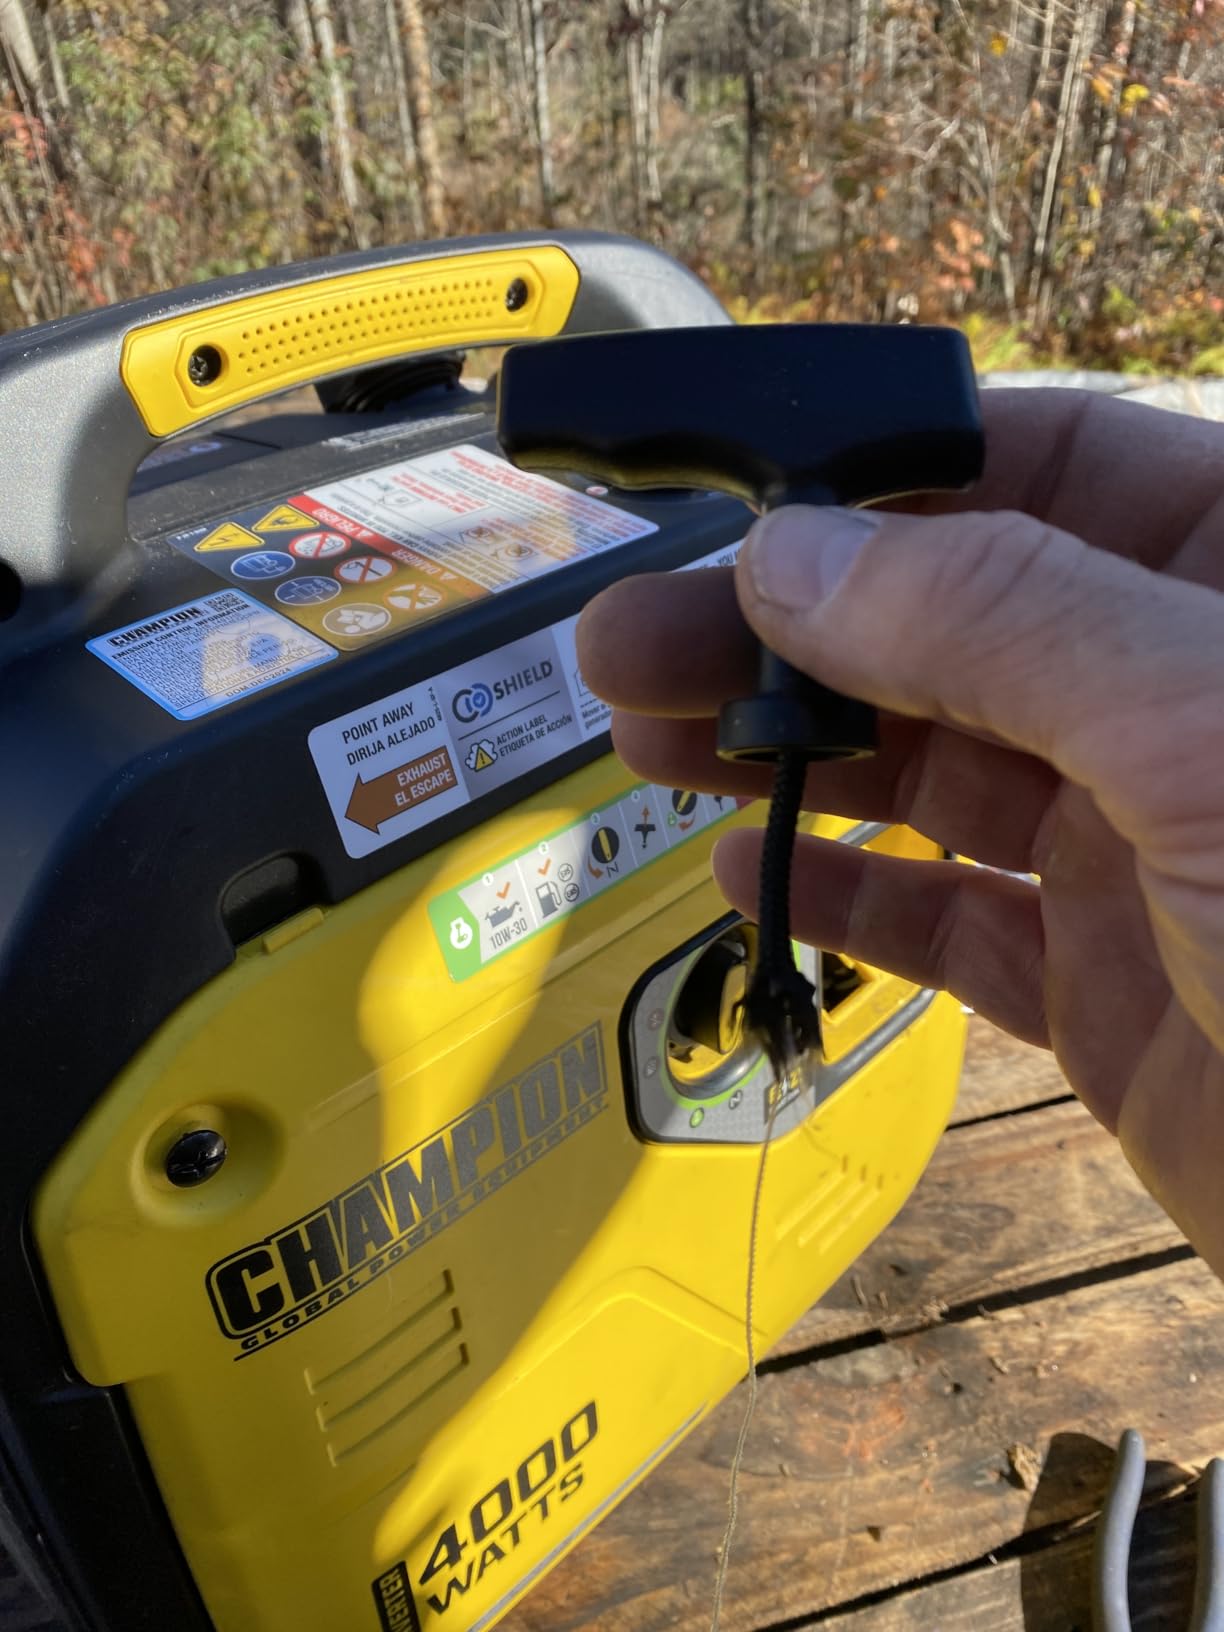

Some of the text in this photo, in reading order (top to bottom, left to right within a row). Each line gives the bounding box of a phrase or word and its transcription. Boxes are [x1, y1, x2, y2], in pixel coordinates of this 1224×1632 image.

[392, 549, 440, 574] DANGER
[107, 606, 202, 646] CHAMPION
[111, 640, 155, 659] EMISSION
[153, 624, 194, 642] CONTROL
[193, 603, 250, 626] INFORMATION
[493, 660, 553, 700] SHIELD
[342, 718, 378, 744] POINT
[382, 702, 414, 727] AWAY
[347, 716, 436, 765] DIRIJA ALEJADO
[497, 714, 548, 746] ACTION LABEL
[499, 714, 572, 757] ETIQUETA DE ACCIÓN
[394, 768, 453, 806] EL ESCAPE
[397, 752, 447, 786] EXHAUST
[489, 918, 528, 950] 10W-30
[210, 1025, 608, 1335] CHAMPION
[240, 1276, 360, 1351] GLOBAL
[369, 1201, 465, 1274] POWER
[419, 1400, 598, 1586] 4000
[427, 1462, 585, 1615] WATTS
[380, 1567, 418, 1632] VERTER
